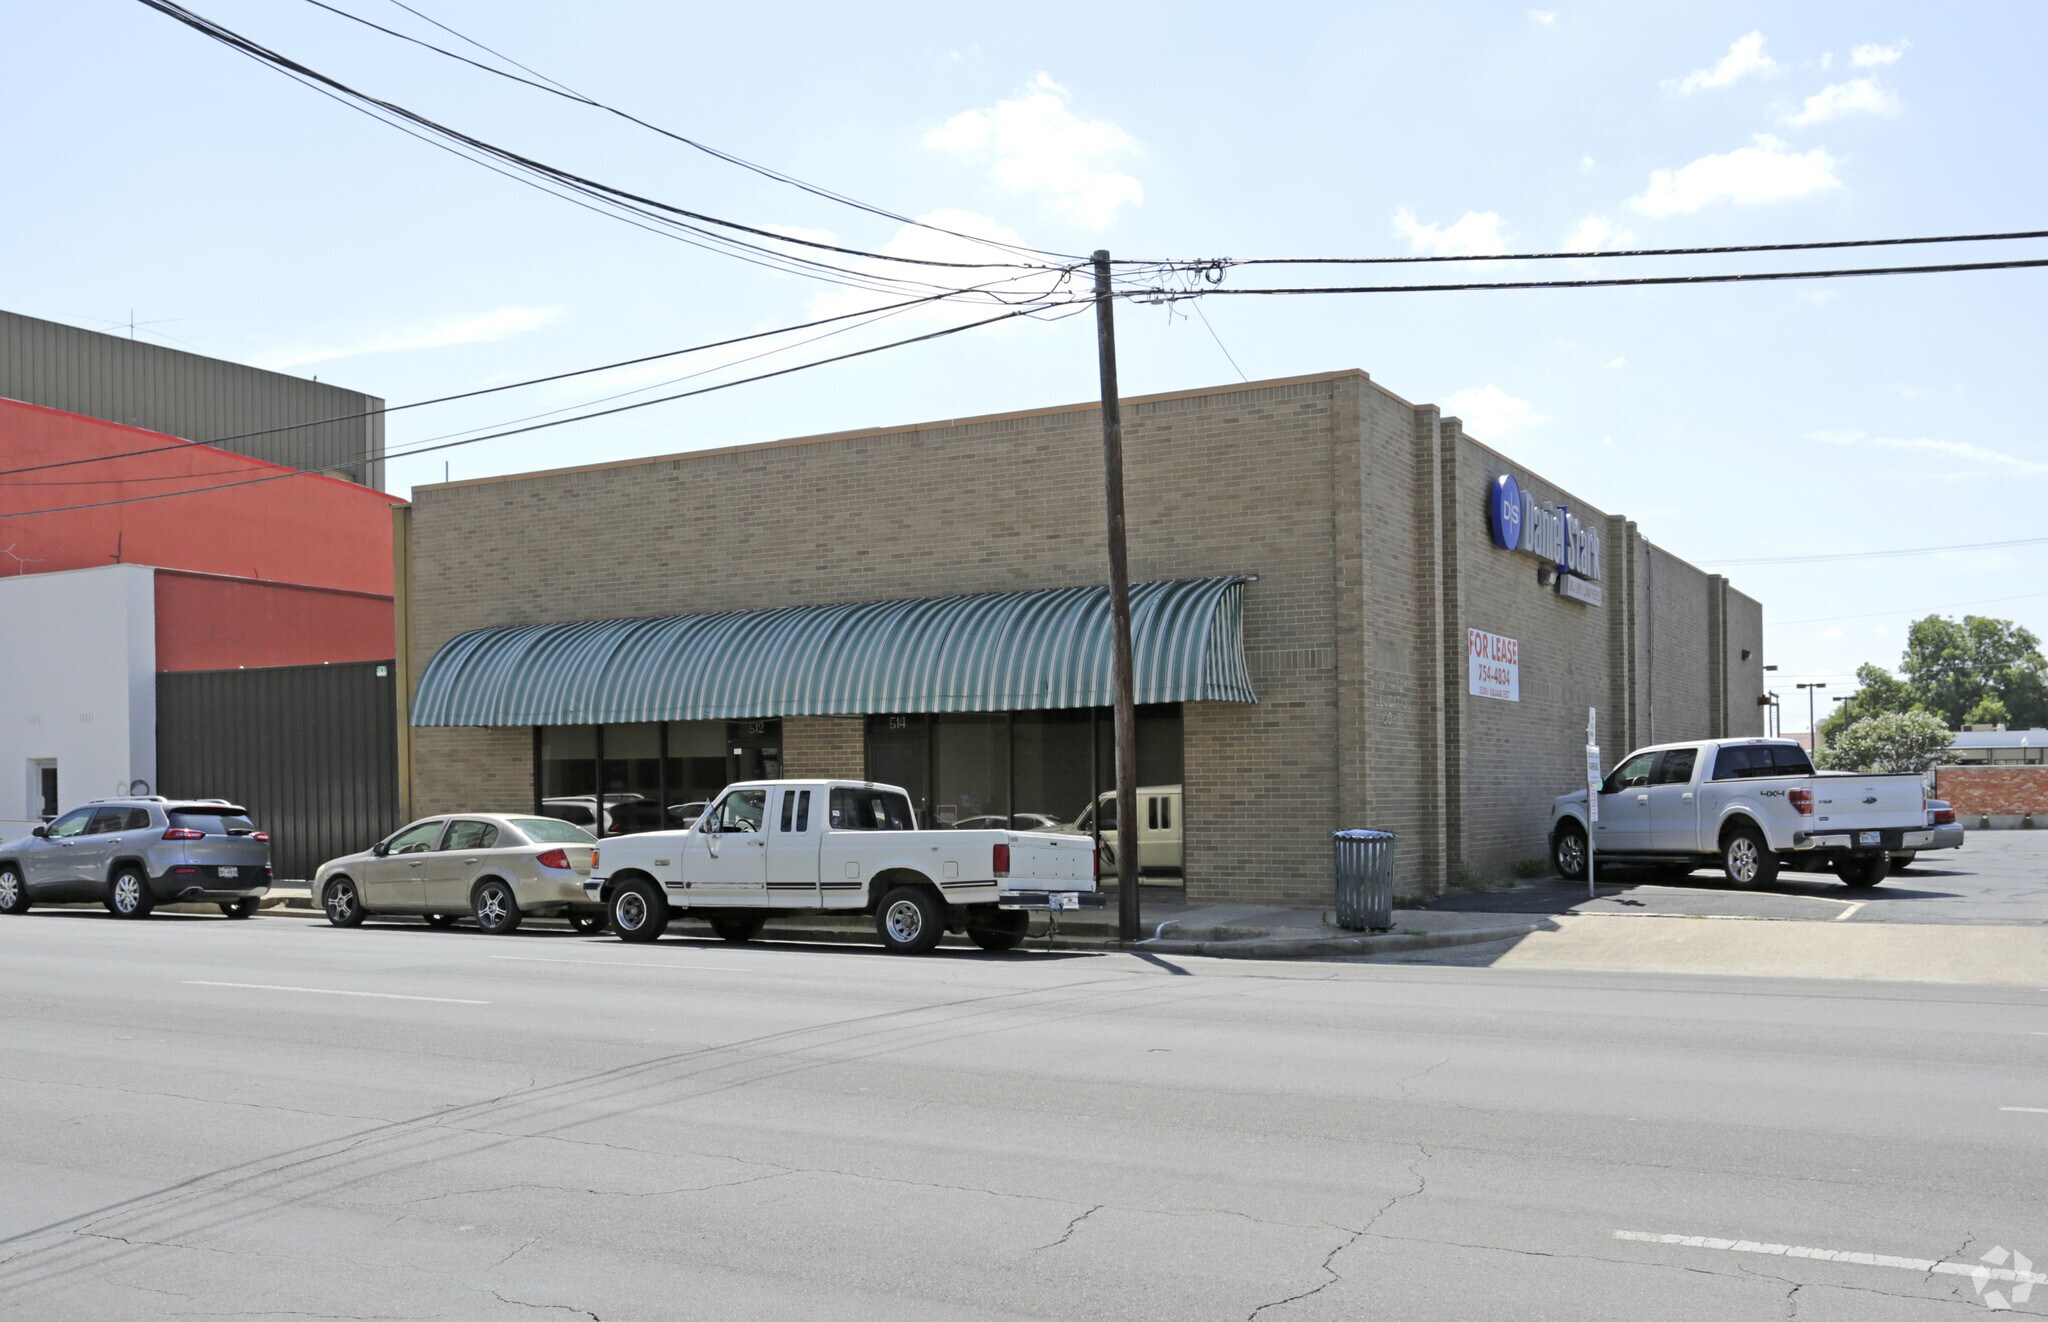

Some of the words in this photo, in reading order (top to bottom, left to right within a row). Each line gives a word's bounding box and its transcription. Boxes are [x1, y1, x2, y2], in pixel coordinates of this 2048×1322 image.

[1523, 490, 1565, 566] Daniel
[1567, 514, 1600, 580] Stark
[1469, 630, 1488, 659] FOR
[1491, 636, 1517, 665] LEASE
[1479, 664, 1510, 686] 754-4834
[749, 720, 764, 734] 512
[889, 716, 906, 729] 514
